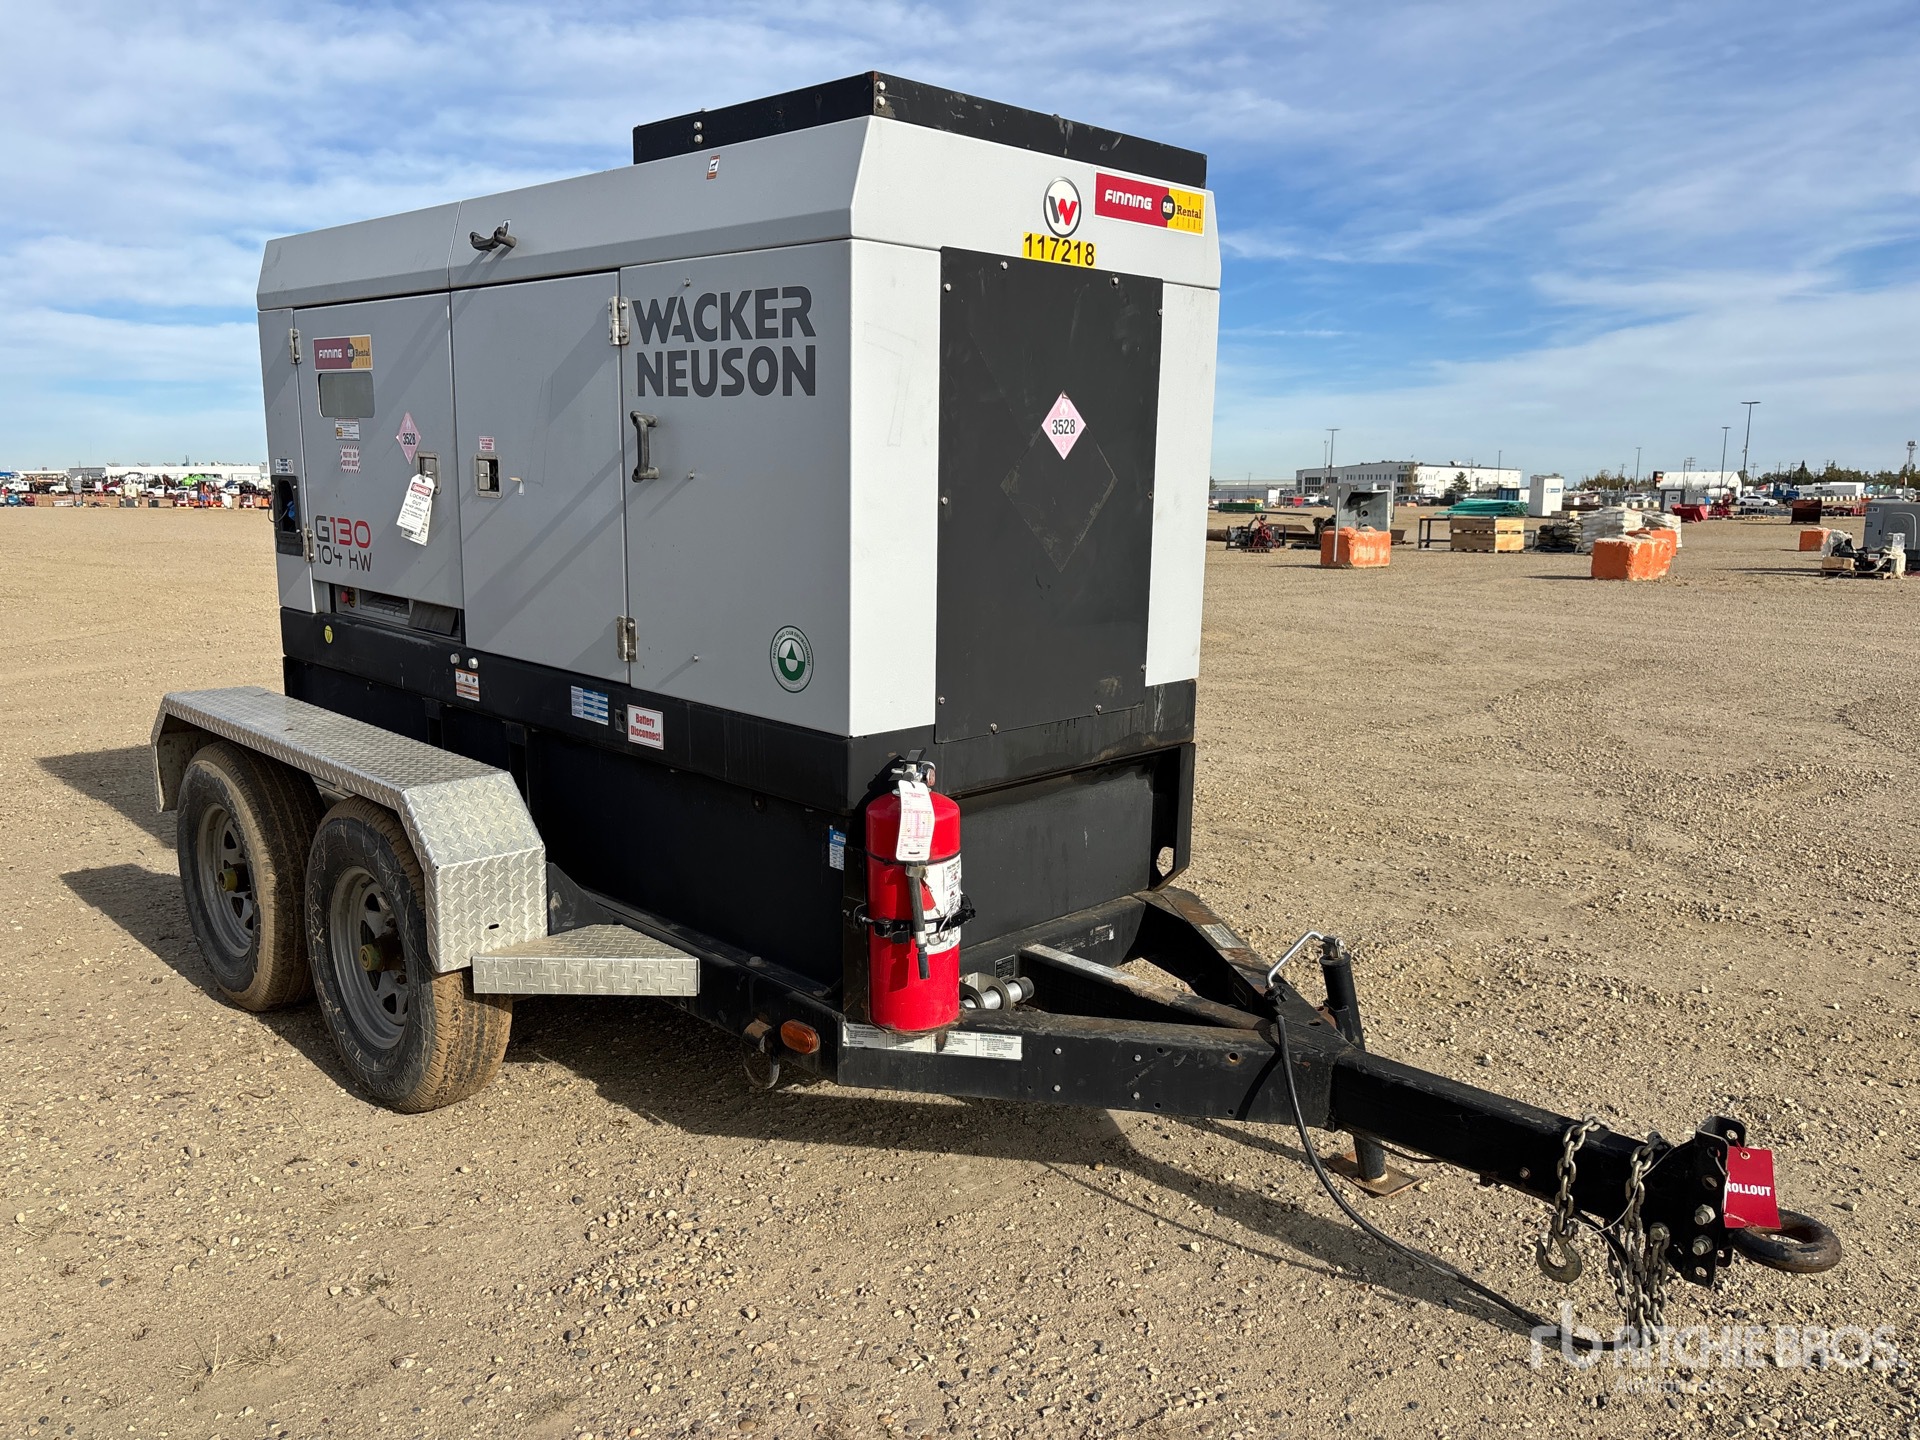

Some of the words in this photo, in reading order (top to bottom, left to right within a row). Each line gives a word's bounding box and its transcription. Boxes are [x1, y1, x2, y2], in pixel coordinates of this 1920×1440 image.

[1104, 189, 1153, 211] FINNING
[1162, 201, 1174, 214] CAT
[1176, 204, 1202, 220] Rental
[1023, 233, 1096, 267] 117218
[632, 285, 817, 345] WACKER
[318, 348, 343, 360] FINNING
[636, 345, 817, 398] NEUSON
[1051, 418, 1076, 435] 3528
[402, 432, 416, 446] 3528
[409, 492, 429, 503] LOCKED
[315, 515, 371, 549] G130
[316, 544, 343, 567] 104
[635, 713, 656, 728] Battery
[630, 725, 661, 742] Disconnect
